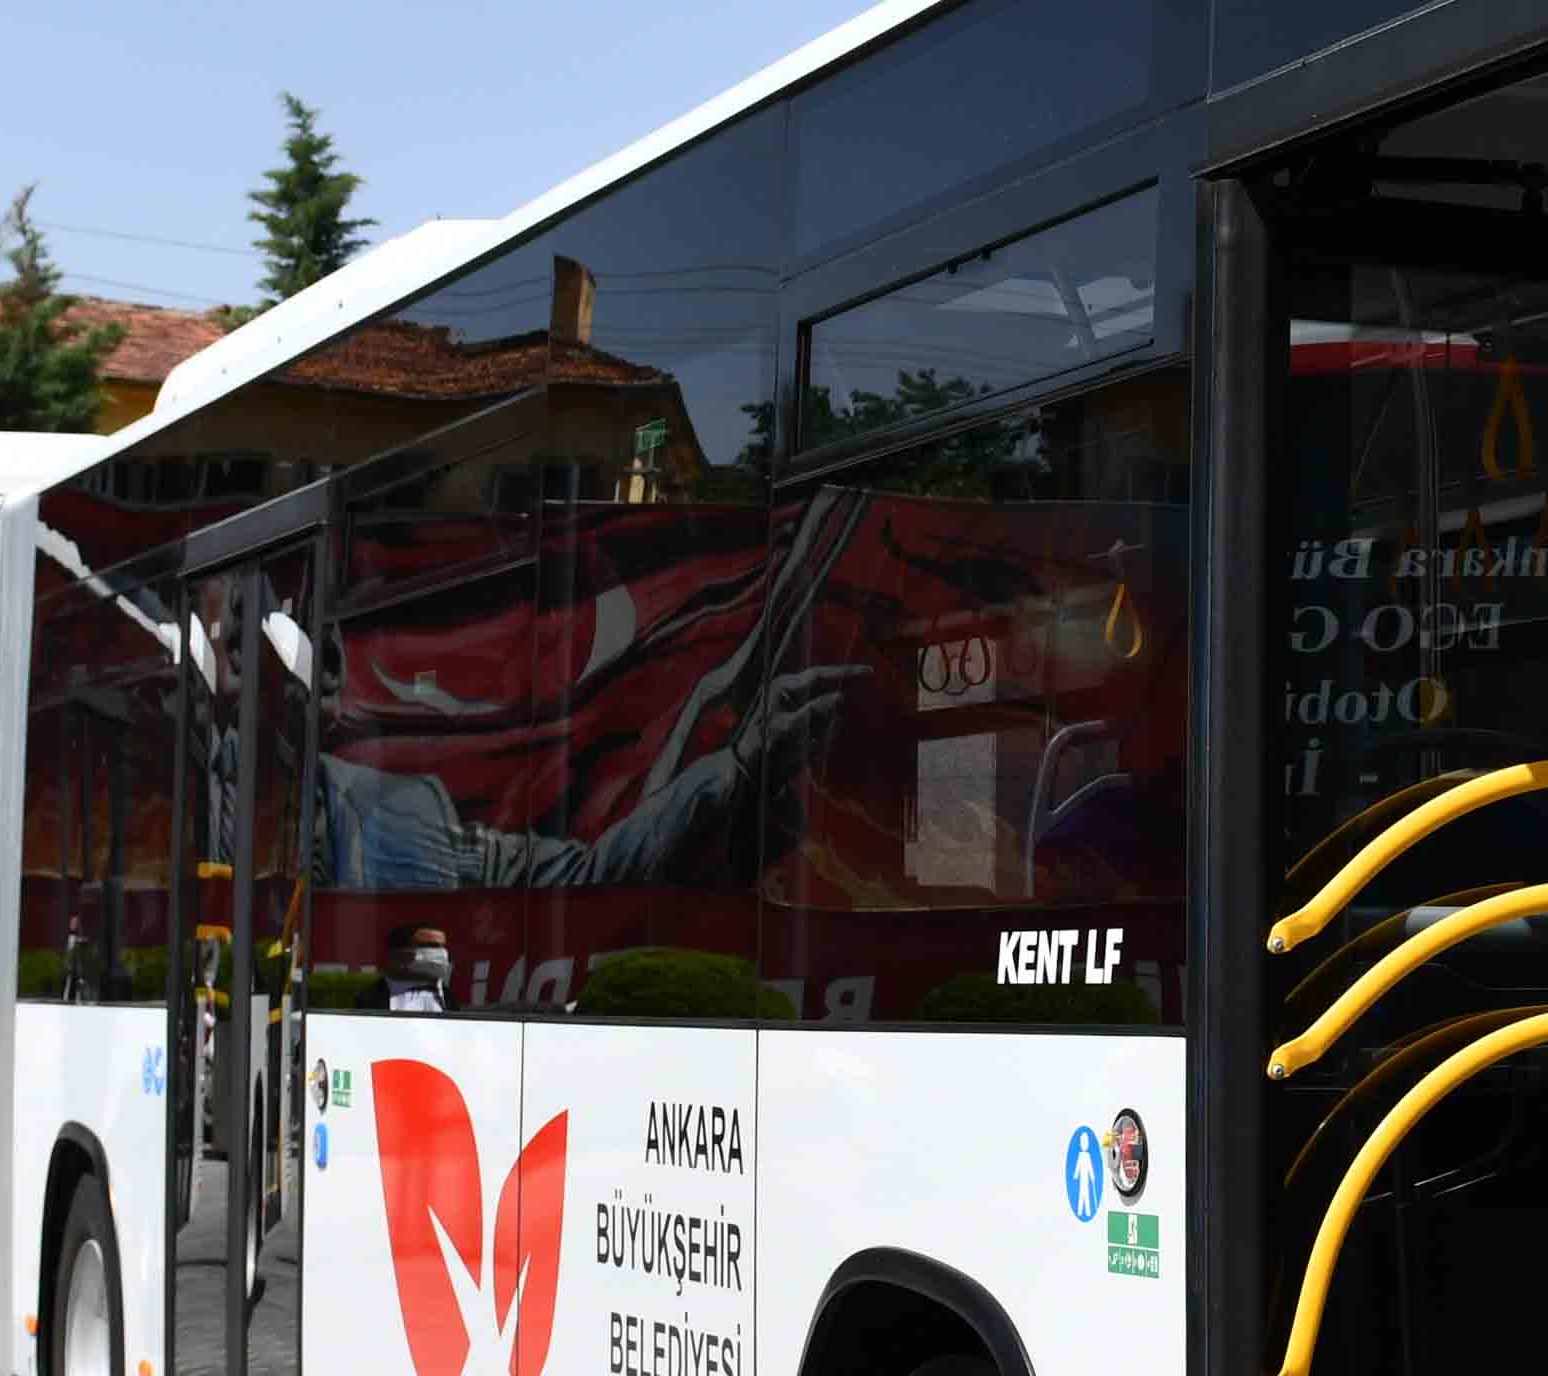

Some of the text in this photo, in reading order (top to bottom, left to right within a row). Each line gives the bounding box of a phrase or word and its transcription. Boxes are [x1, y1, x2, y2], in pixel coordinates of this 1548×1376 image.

[997, 928, 1123, 985] KENT LF
[645, 1100, 744, 1176] ANKARA
[596, 1188, 743, 1297] BÜYÜKŞEHİR
